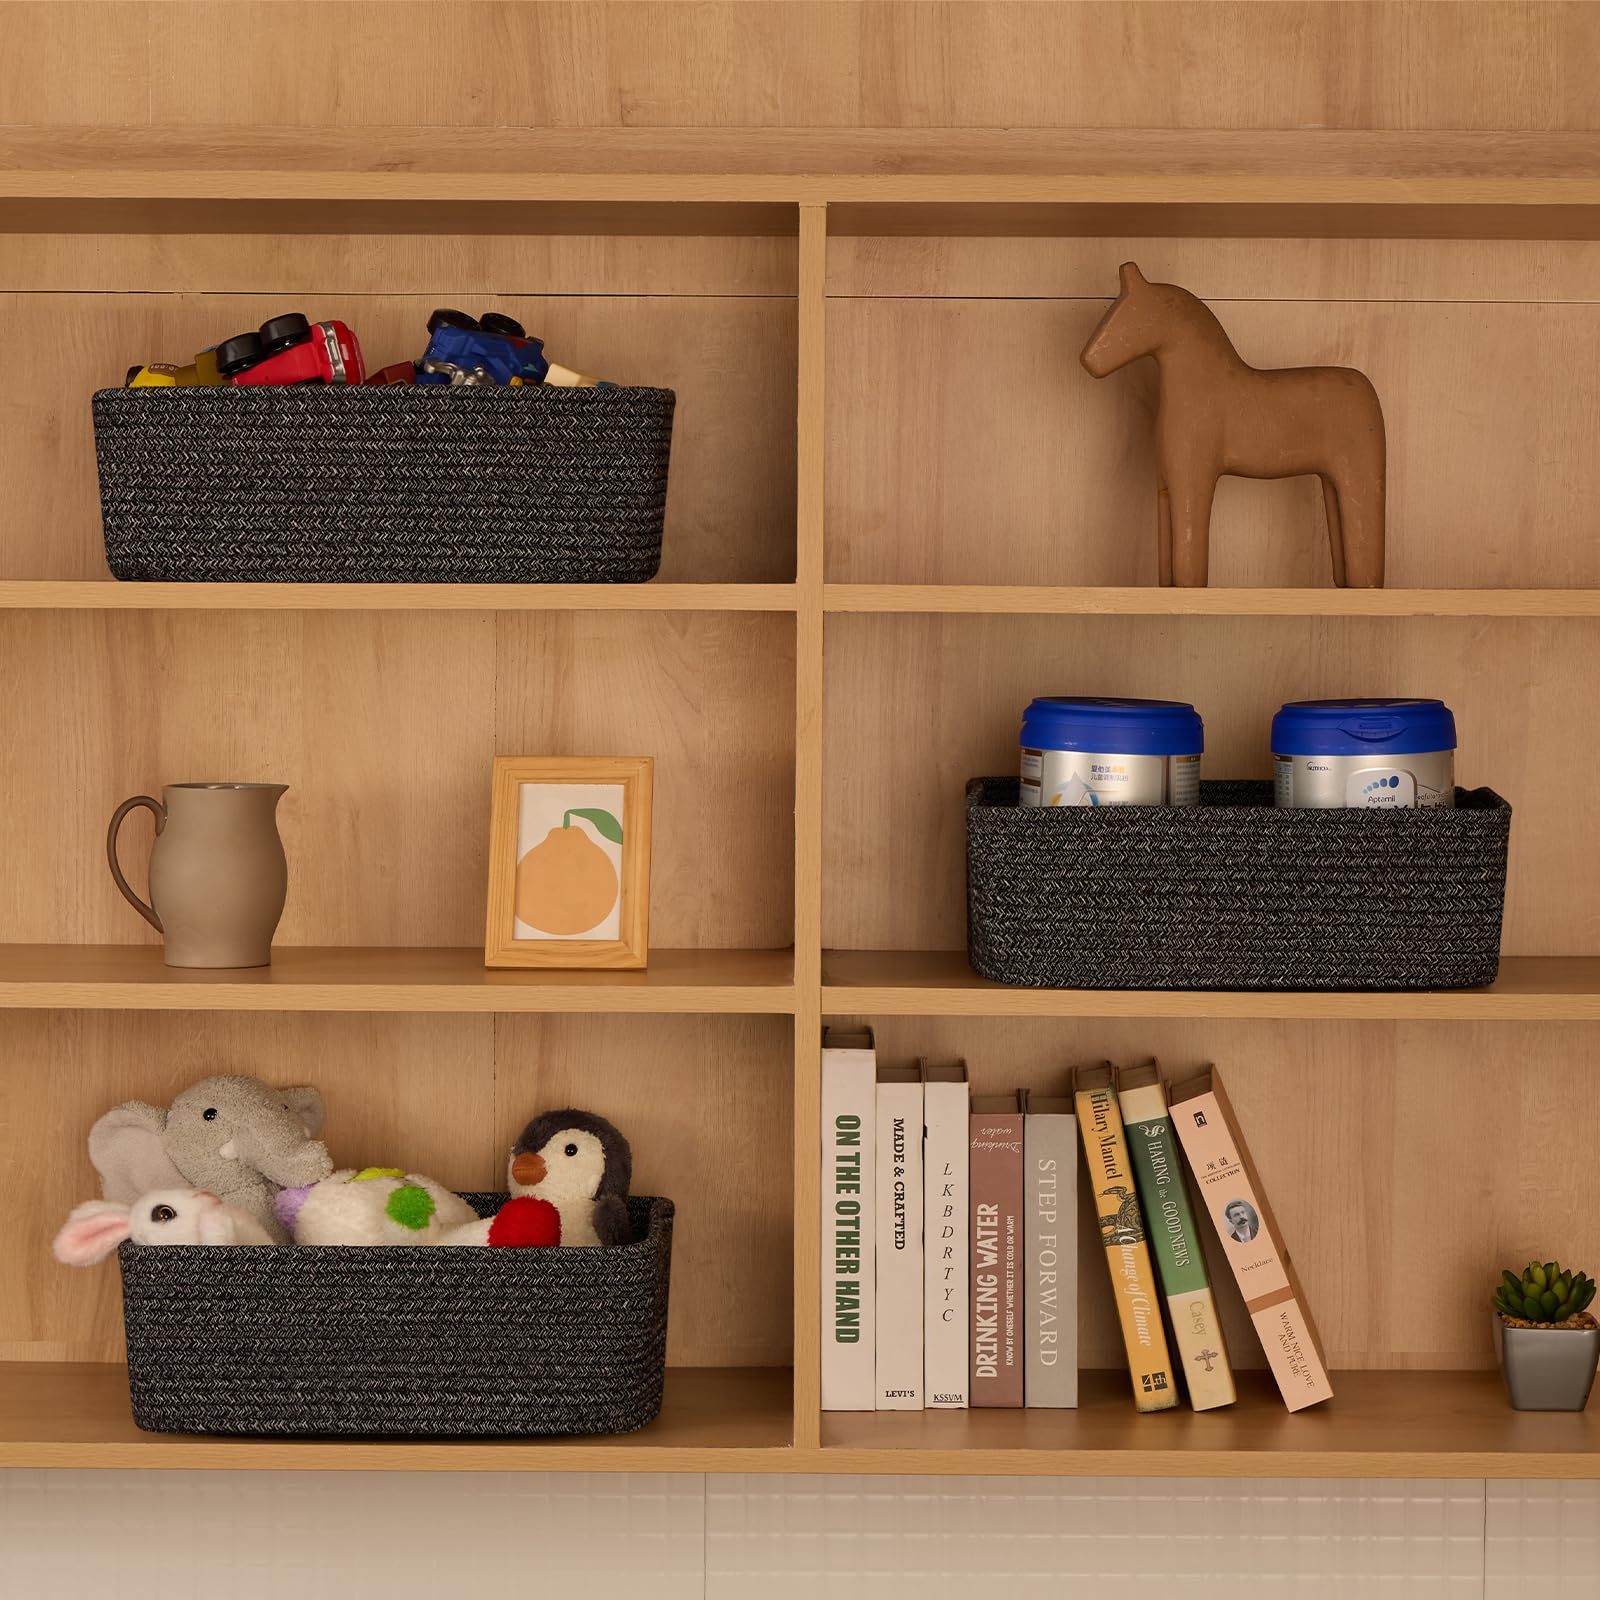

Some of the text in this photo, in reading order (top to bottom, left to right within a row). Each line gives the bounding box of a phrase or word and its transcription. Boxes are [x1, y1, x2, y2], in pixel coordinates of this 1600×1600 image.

[1367, 789, 1396, 803] Aptamil
[970, 1138, 1022, 1153] Drinking
[1090, 1091, 1123, 1180] Hilary Mantel
[893, 1118, 906, 1250] MADE & CRAFTED
[1205, 1168, 1241, 1185] COLLECTION
[835, 1114, 862, 1344] ON THE OTHER HAND
[1162, 1201, 1182, 1233] GOOD
[1039, 1159, 1058, 1367] STEP FORWARD
[1119, 1236, 1139, 1281] Change
[1170, 1233, 1190, 1268] NEWS
[1240, 1256, 1275, 1273] Necklace
[975, 1203, 999, 1377] DRINKING WATER
[1006, 1215, 1014, 1366] KNOW BY ONESELF WHETHER IT IS COLD OR WARM
[1123, 1282, 1148, 1297] of
[1131, 1297, 1152, 1347] Climate
[1189, 1301, 1207, 1336] Casey
[1278, 1333, 1301, 1378] AND PURE
[1280, 1311, 1315, 1388] WARM NICE LOVE
[885, 1389, 915, 1399] LEVI'S
